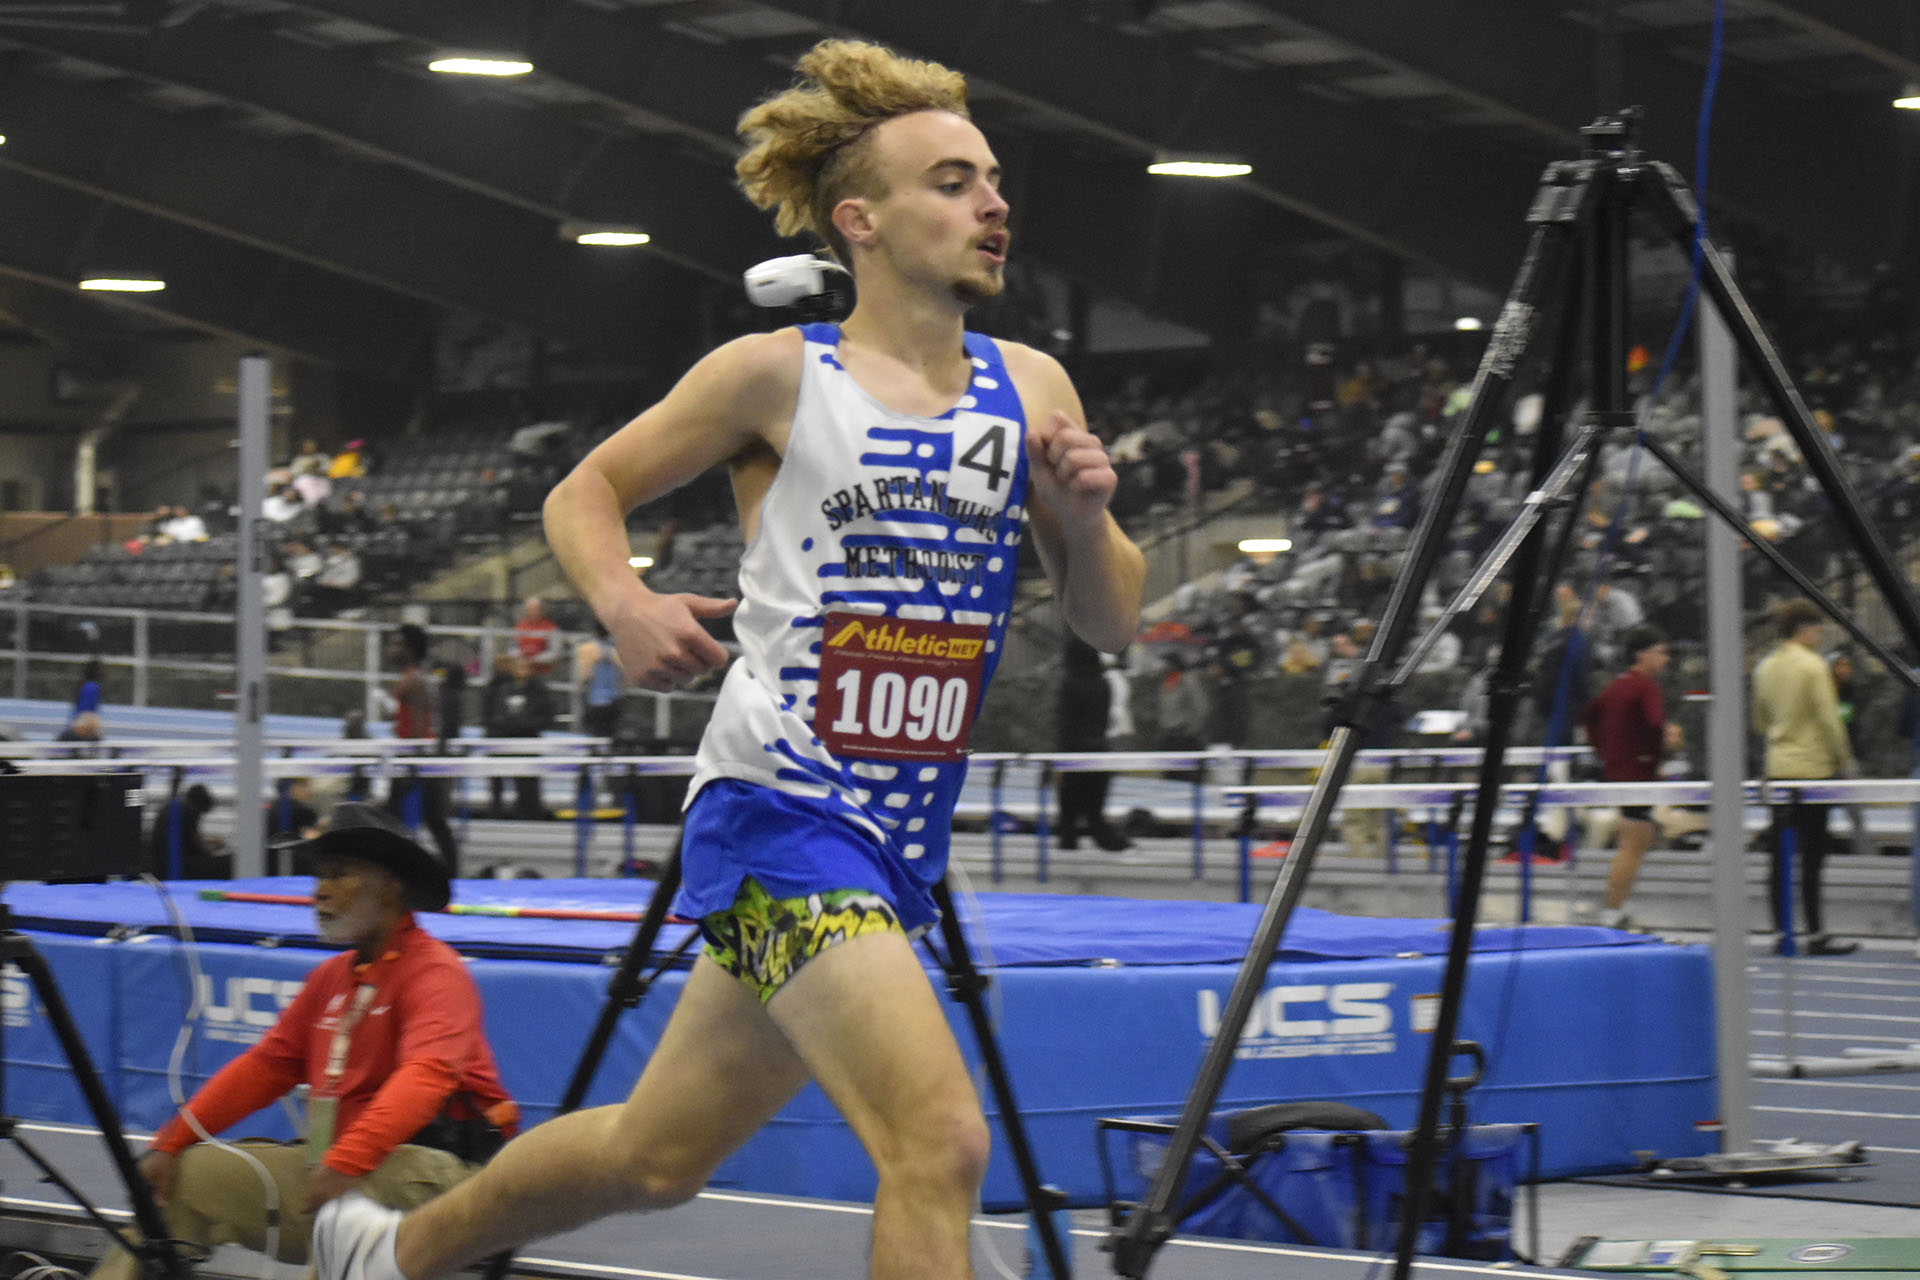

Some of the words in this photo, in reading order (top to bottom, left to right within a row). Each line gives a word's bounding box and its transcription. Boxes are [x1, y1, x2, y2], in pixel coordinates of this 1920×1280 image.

[958, 425, 1010, 492] 4
[844, 546, 985, 585] METHODIST
[827, 620, 952, 658] Athletic
[832, 669, 968, 742] 1090
